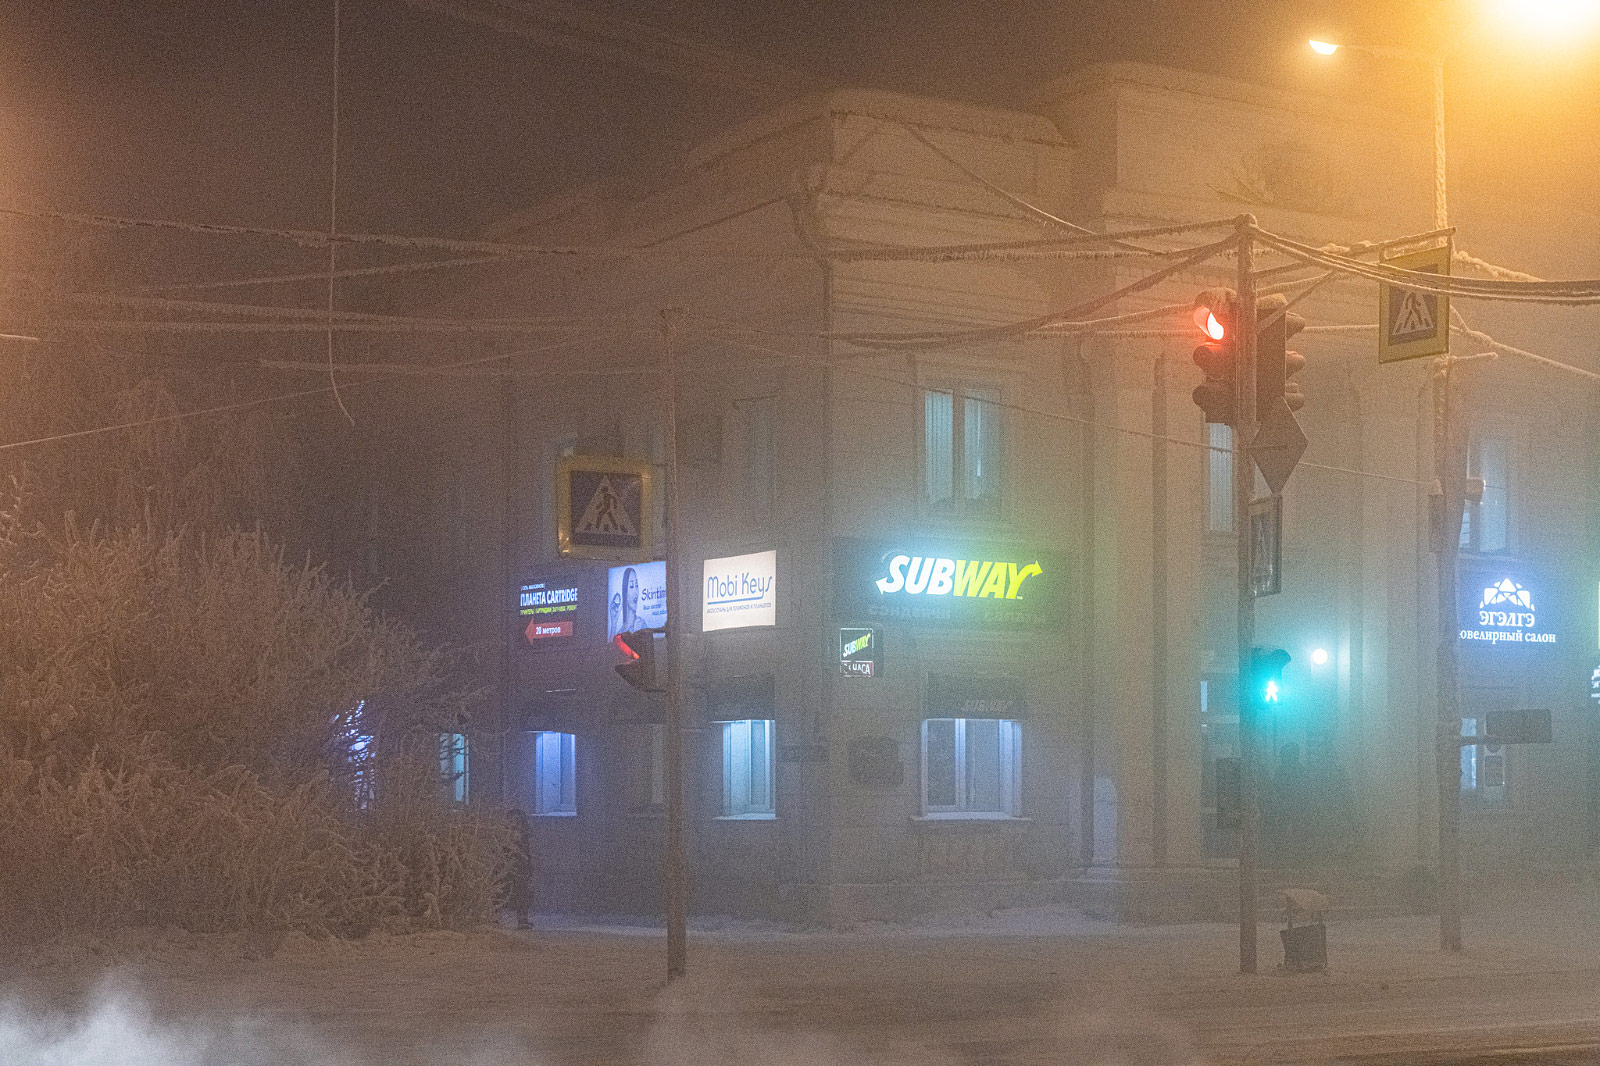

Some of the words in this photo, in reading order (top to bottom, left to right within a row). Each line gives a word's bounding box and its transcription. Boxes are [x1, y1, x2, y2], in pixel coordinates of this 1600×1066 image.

[707, 574, 738, 599] Mobi
[741, 572, 773, 600] Keys
[876, 555, 1043, 600] SUBWAY
[520, 591, 546, 606] ПЛАНЕТА
[546, 588, 578, 604] CARTRIDGE
[1479, 610, 1536, 628] ЭГЭЛГЭ
[843, 633, 871, 658] SUBWAY
[1524, 632, 1556, 643] салон
